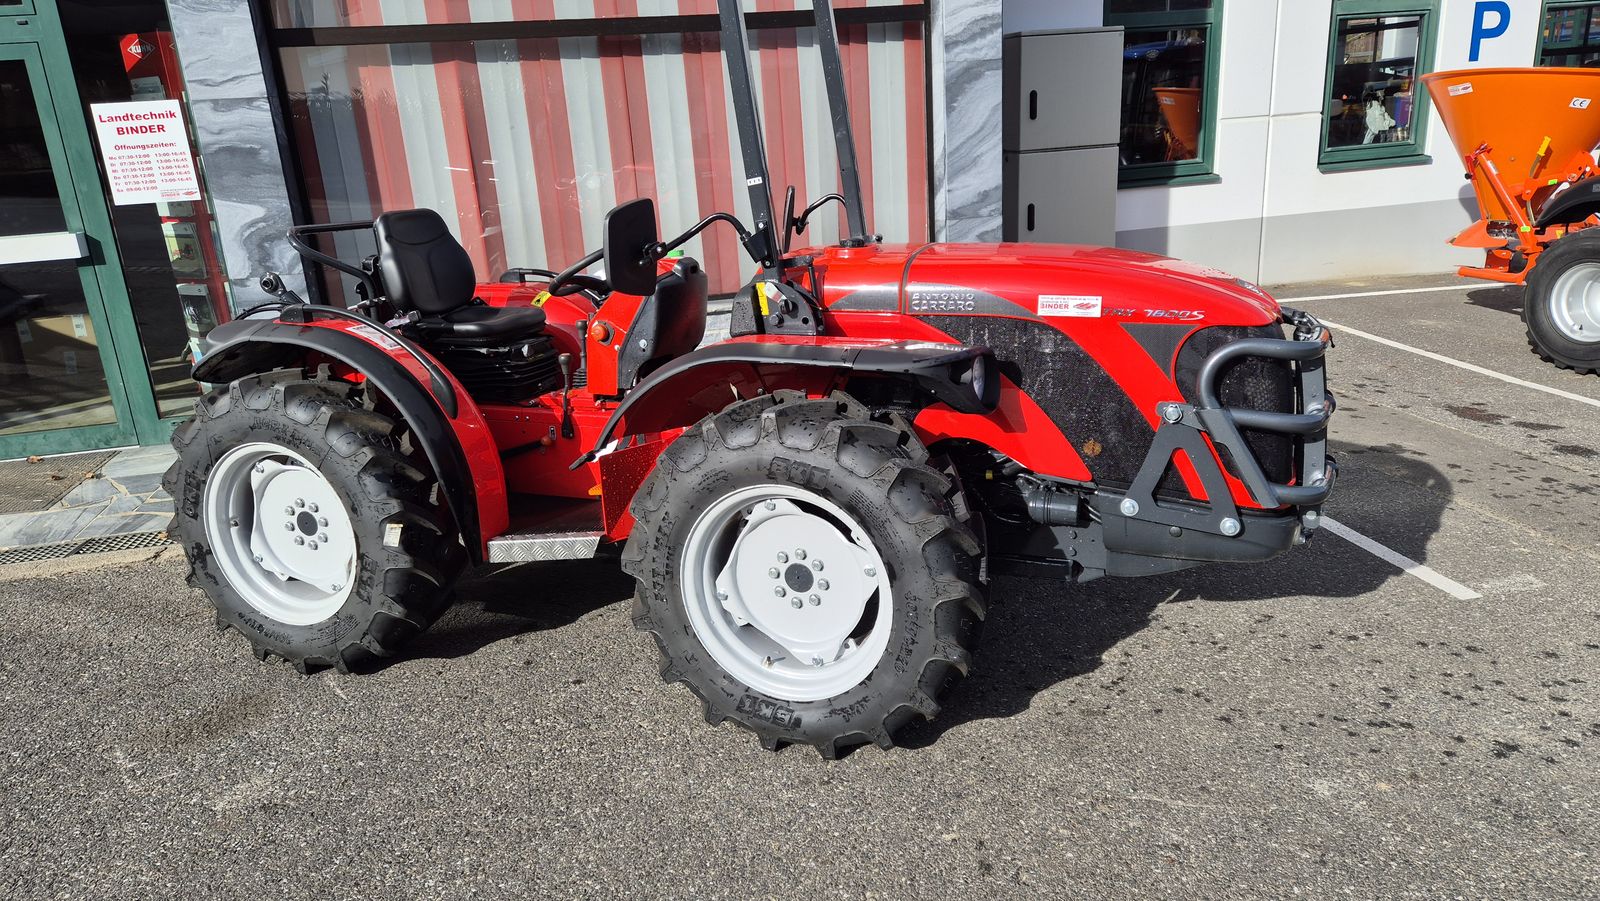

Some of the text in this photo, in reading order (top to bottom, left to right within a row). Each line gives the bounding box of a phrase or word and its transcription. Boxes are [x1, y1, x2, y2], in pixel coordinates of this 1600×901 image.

[1468, 1, 1511, 62] P
[98, 110, 176, 122] Landtechnik
[116, 124, 166, 135] BINDER
[912, 301, 975, 310] CARRARO
